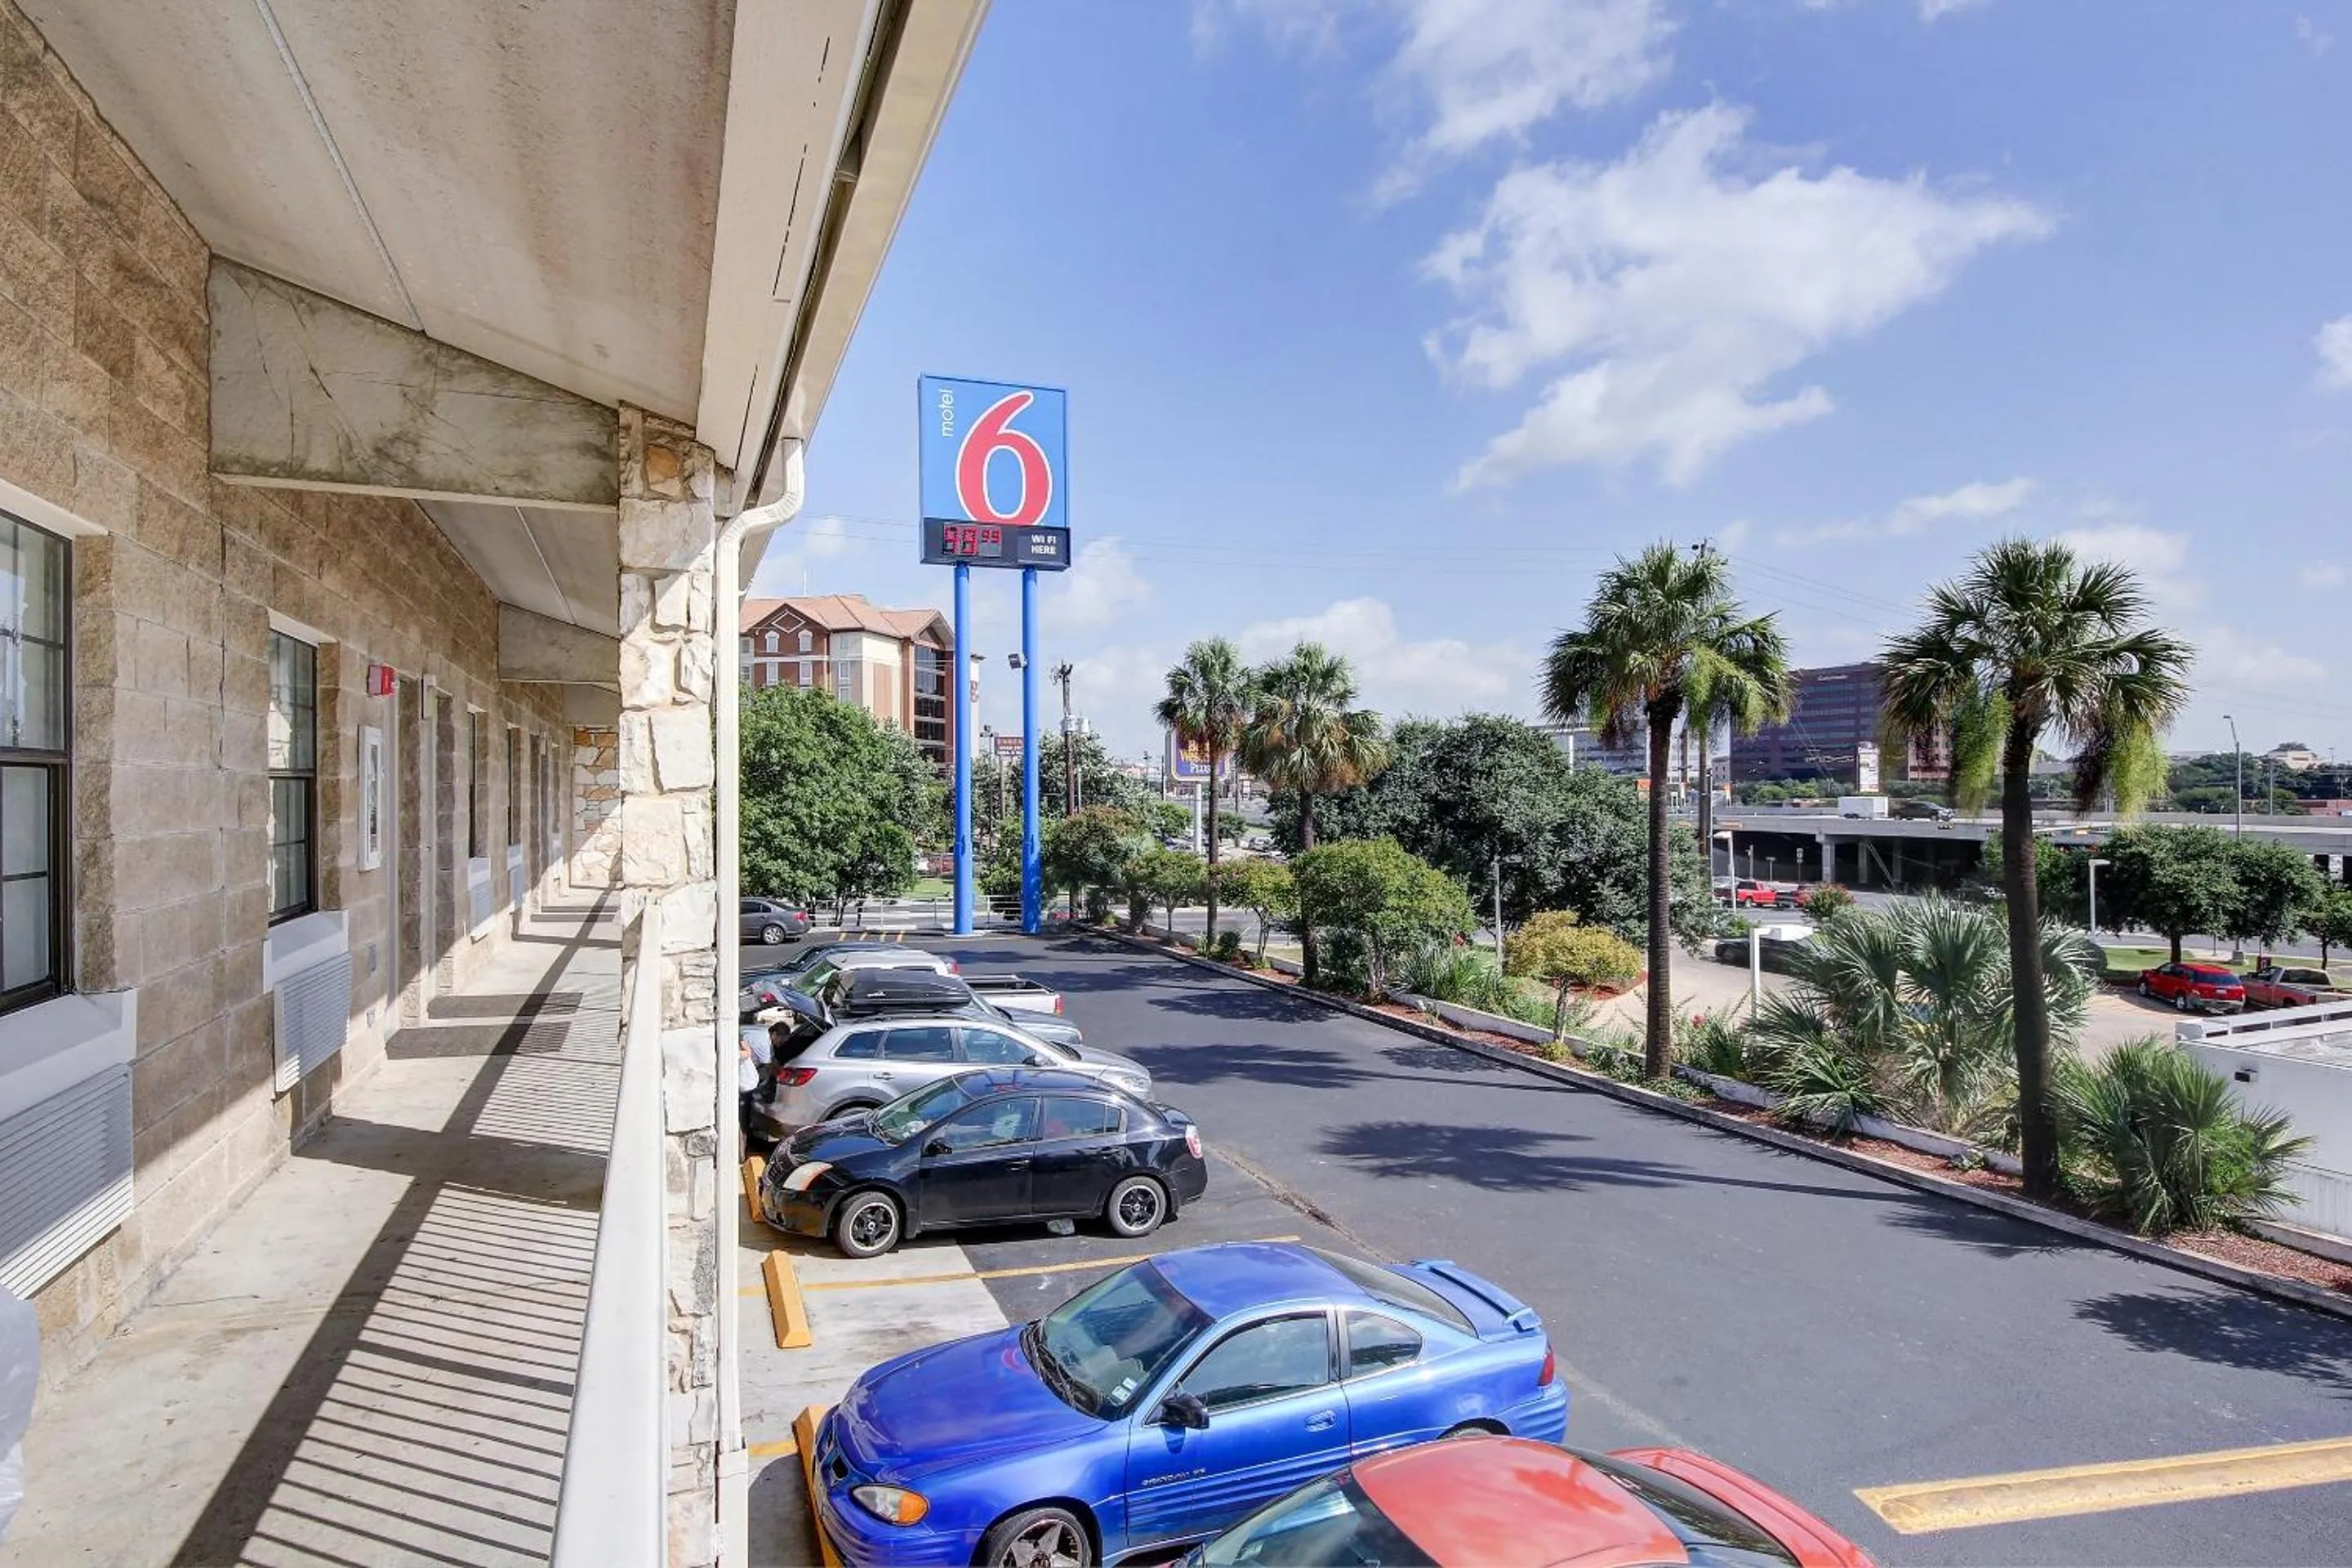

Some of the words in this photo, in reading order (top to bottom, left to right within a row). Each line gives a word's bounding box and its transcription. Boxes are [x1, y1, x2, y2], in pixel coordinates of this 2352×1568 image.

[940, 388, 954, 438] motel
[955, 390, 1053, 526] 6
[1031, 545, 1057, 555] HERE
